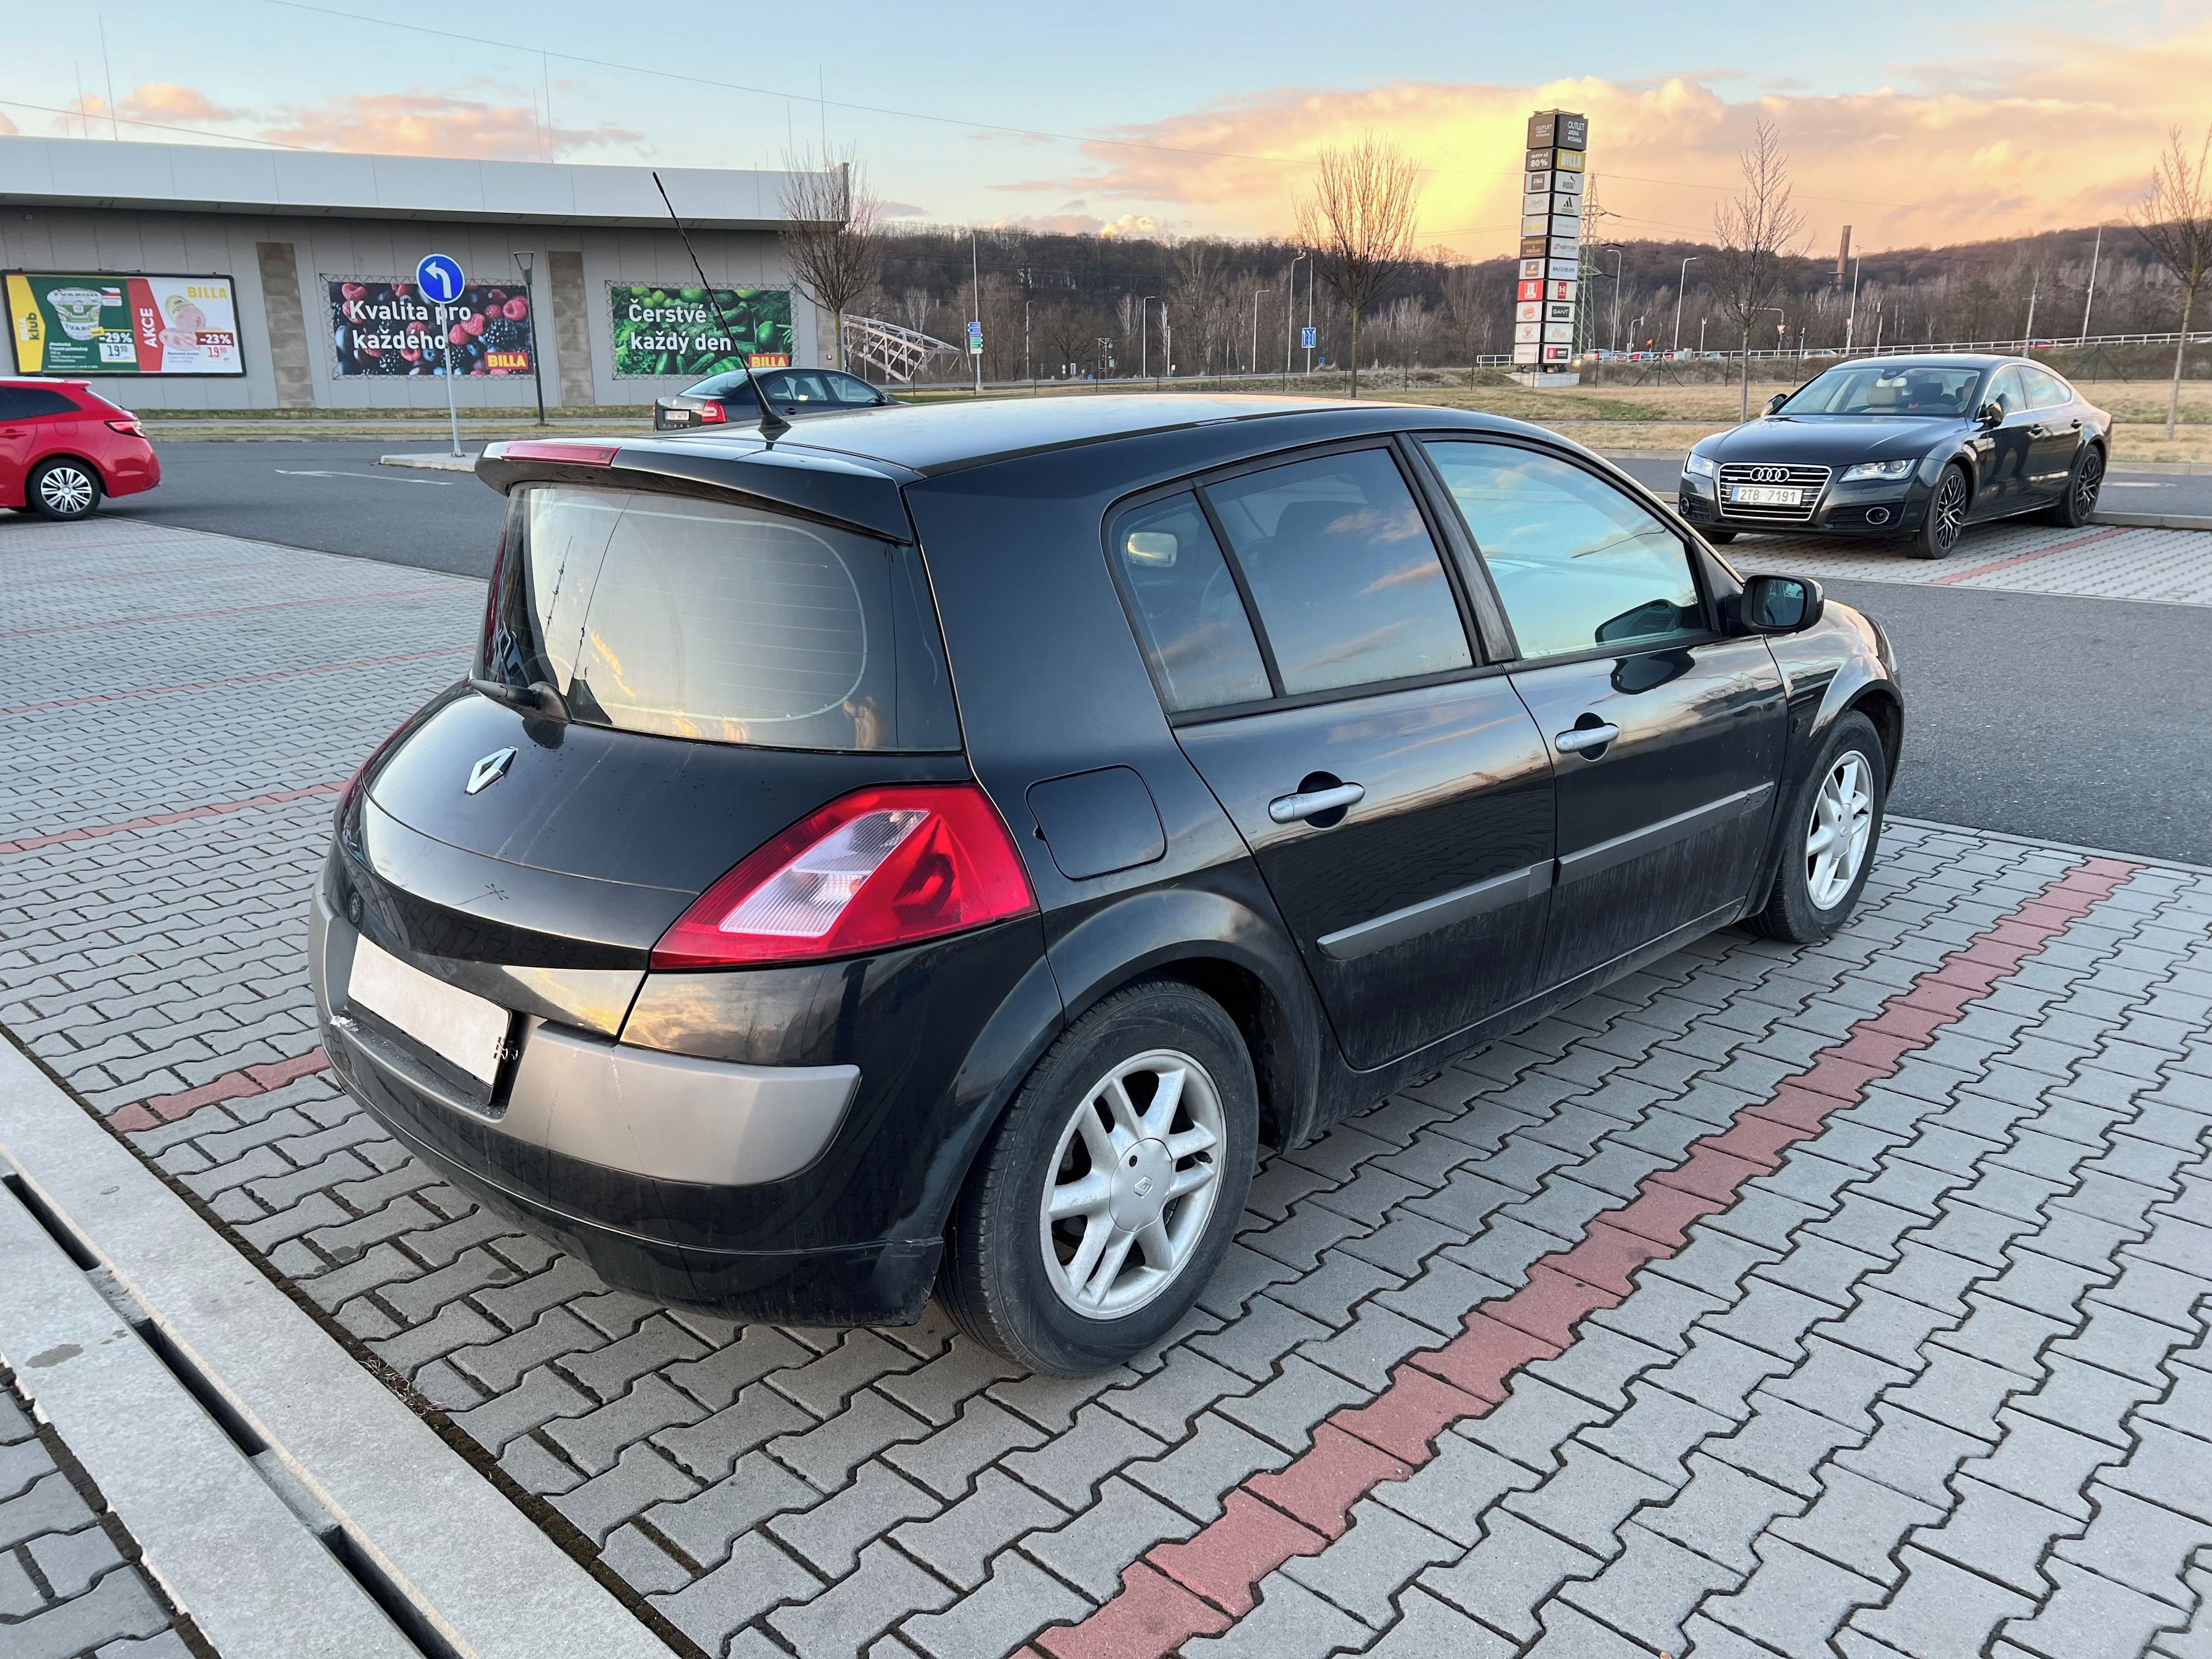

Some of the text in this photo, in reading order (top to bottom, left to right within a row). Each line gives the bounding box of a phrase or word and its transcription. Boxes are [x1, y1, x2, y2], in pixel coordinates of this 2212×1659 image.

[1568, 121, 1584, 131] OUTLET
[1561, 153, 1581, 168] BILLA
[187, 286, 228, 299] BILLA
[349, 300, 471, 324] Kvalita pro
[628, 298, 707, 323] Čerstvé
[26, 312, 40, 340] klub
[140, 307, 159, 348] AKCE
[99, 332, 132, 343] -29%
[200, 334, 231, 345] -23%
[353, 327, 446, 350] každého
[630, 331, 731, 354] každý den
[488, 354, 526, 368] BILLA
[751, 356, 787, 368] BILLA
[1740, 488, 1796, 503] 2TB 7191
